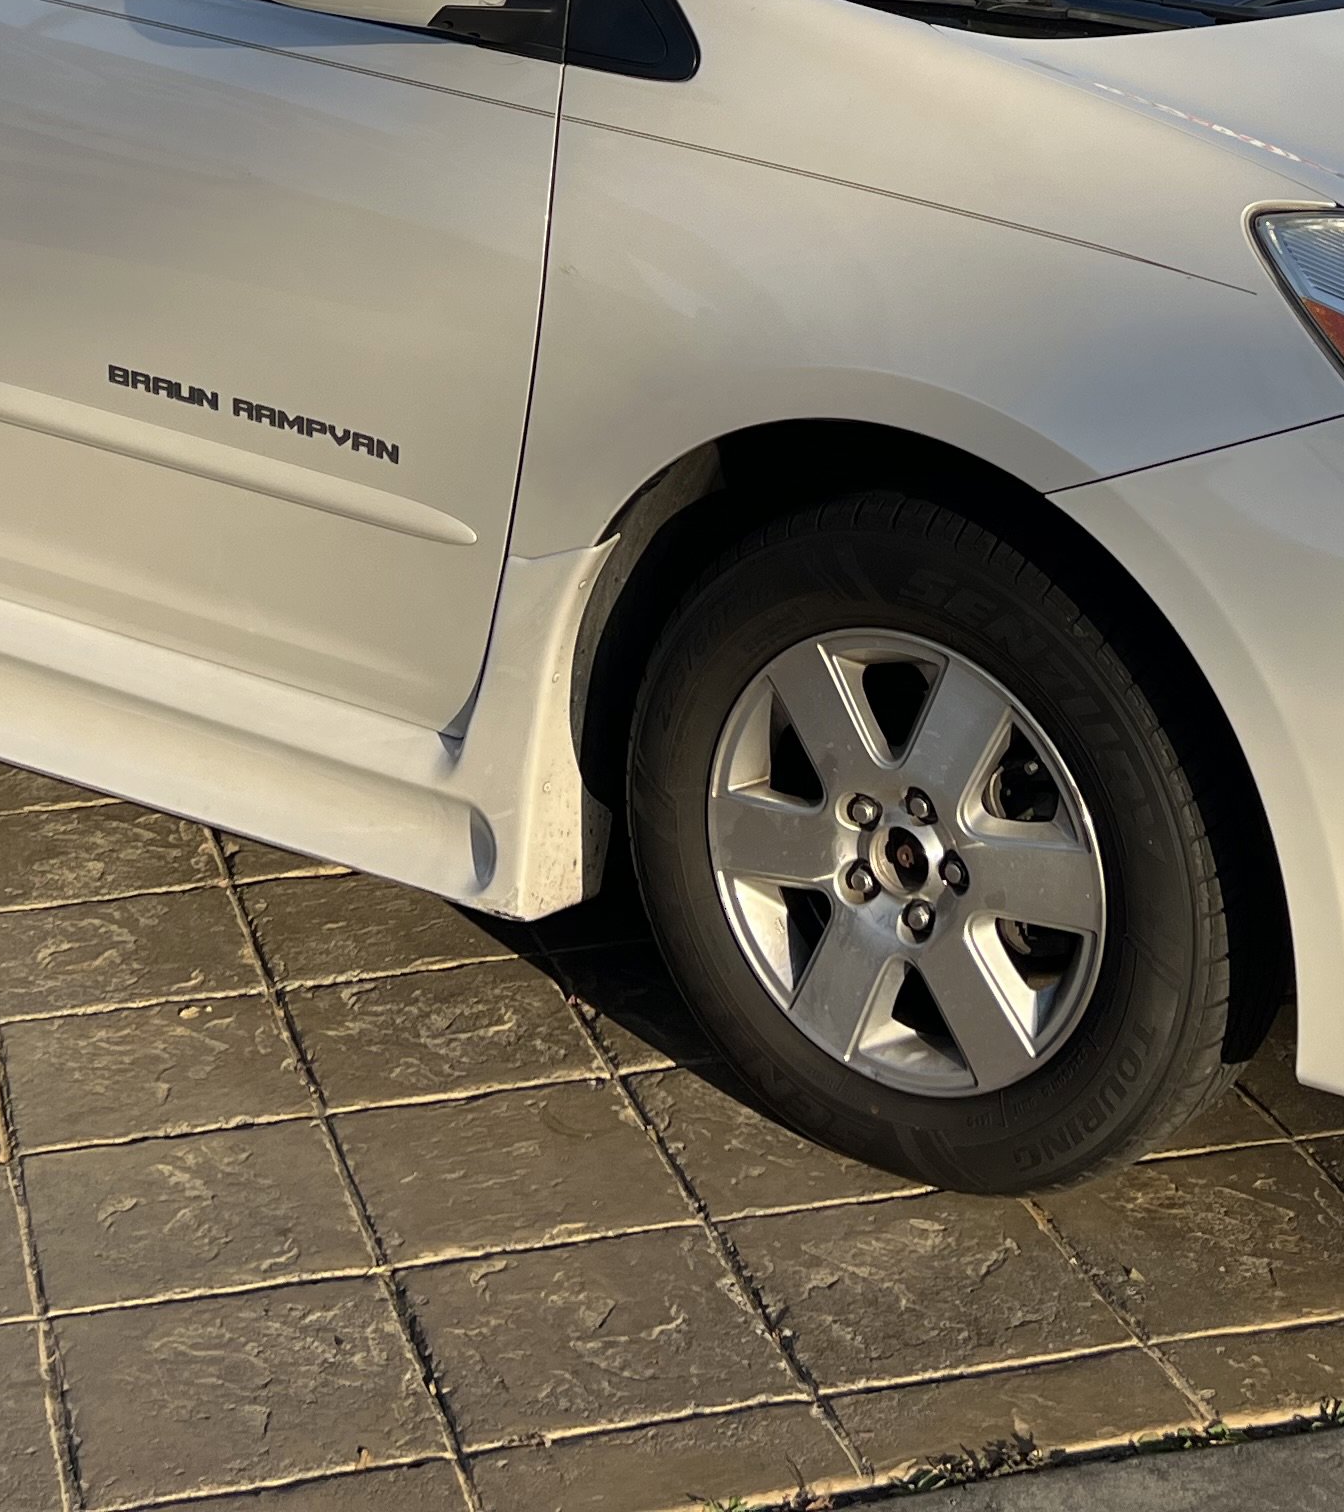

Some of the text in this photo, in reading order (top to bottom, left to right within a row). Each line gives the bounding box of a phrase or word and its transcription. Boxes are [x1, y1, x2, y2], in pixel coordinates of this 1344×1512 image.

[108, 364, 400, 465] BRAUN RAMPVAN
[1012, 1020, 1157, 1172] TOURING
